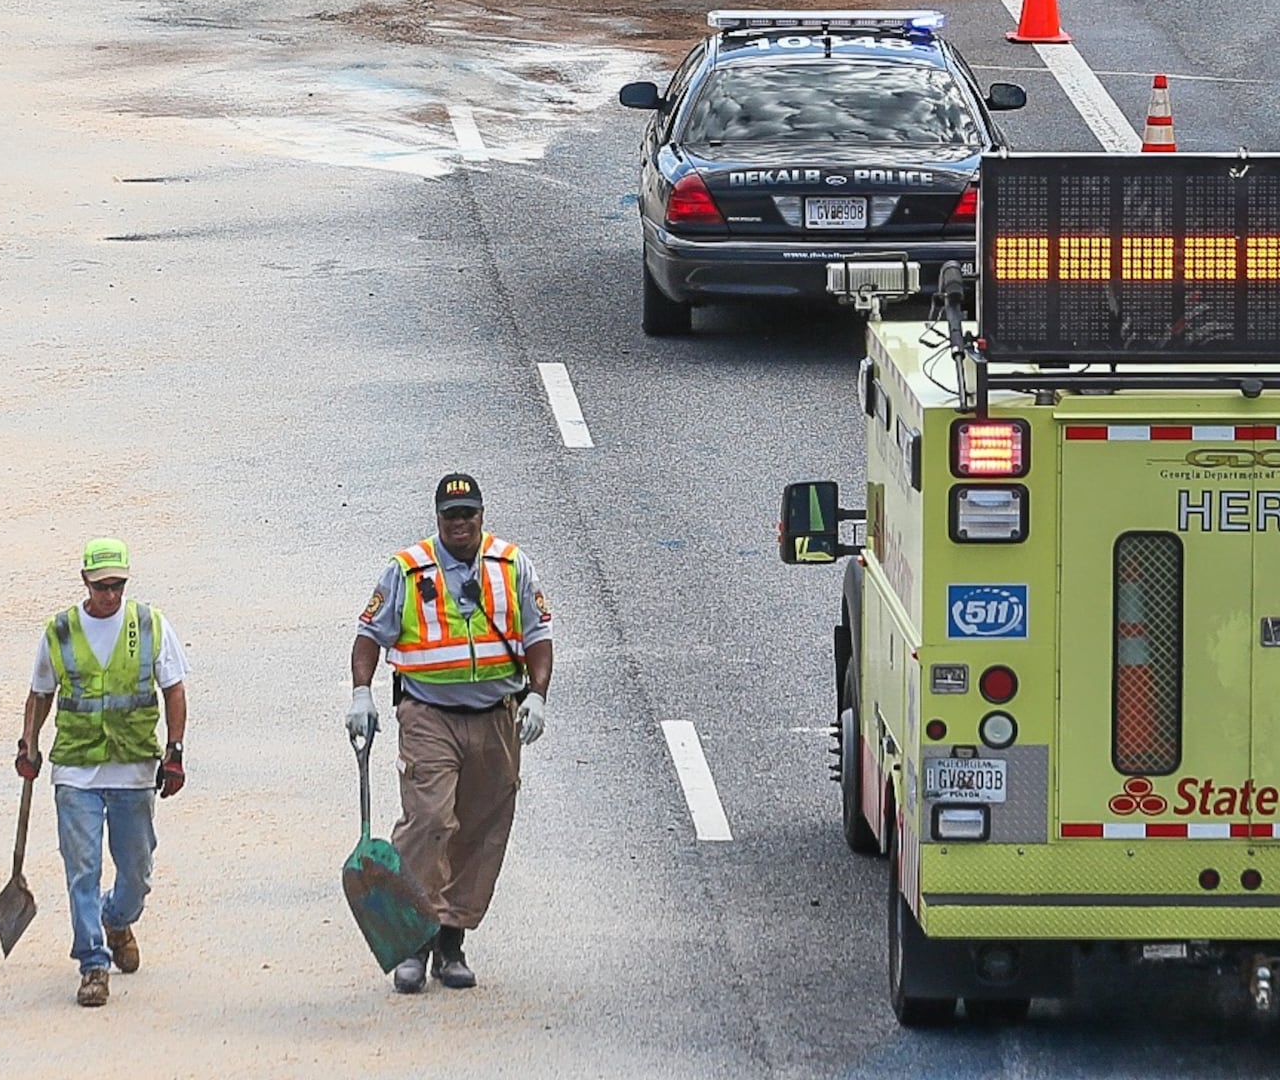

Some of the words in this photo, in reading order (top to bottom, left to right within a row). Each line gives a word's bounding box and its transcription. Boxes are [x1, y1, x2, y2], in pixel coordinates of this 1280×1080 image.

[729, 170, 821, 187] DEKALB
[853, 170, 934, 186] POLICE
[1160, 470, 1200, 481] Georgia
[1204, 470, 1262, 482] Department
[1265, 470, 1276, 480] of
[965, 600, 1010, 625] 511
